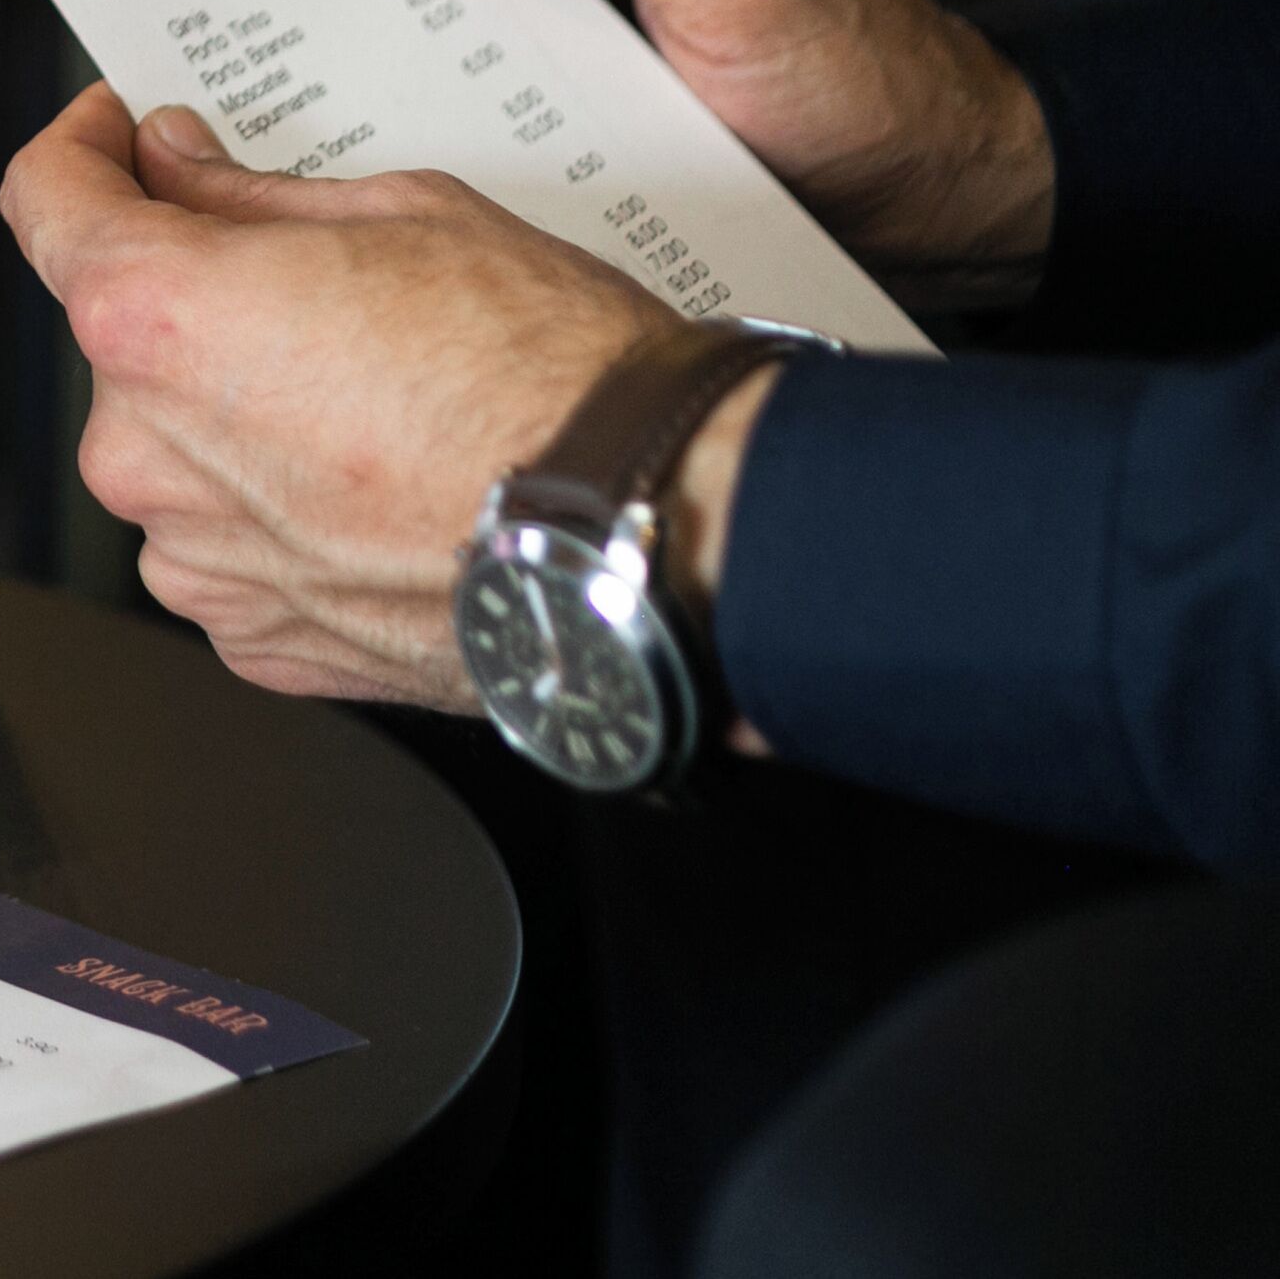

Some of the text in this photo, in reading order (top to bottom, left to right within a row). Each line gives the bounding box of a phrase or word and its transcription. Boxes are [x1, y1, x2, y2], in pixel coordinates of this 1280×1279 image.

[167, 10, 210, 39] Ginja
[182, 11, 271, 65] Porto Tinto
[199, 27, 304, 90] Porto Branco
[217, 69, 290, 118] Moscatel
[234, 85, 325, 140] Espumante
[604, 194, 647, 229] 5.00
[646, 238, 689, 272] 7.00
[682, 282, 731, 320] 12.00
[55, 957, 270, 1035] SNACK BAR
